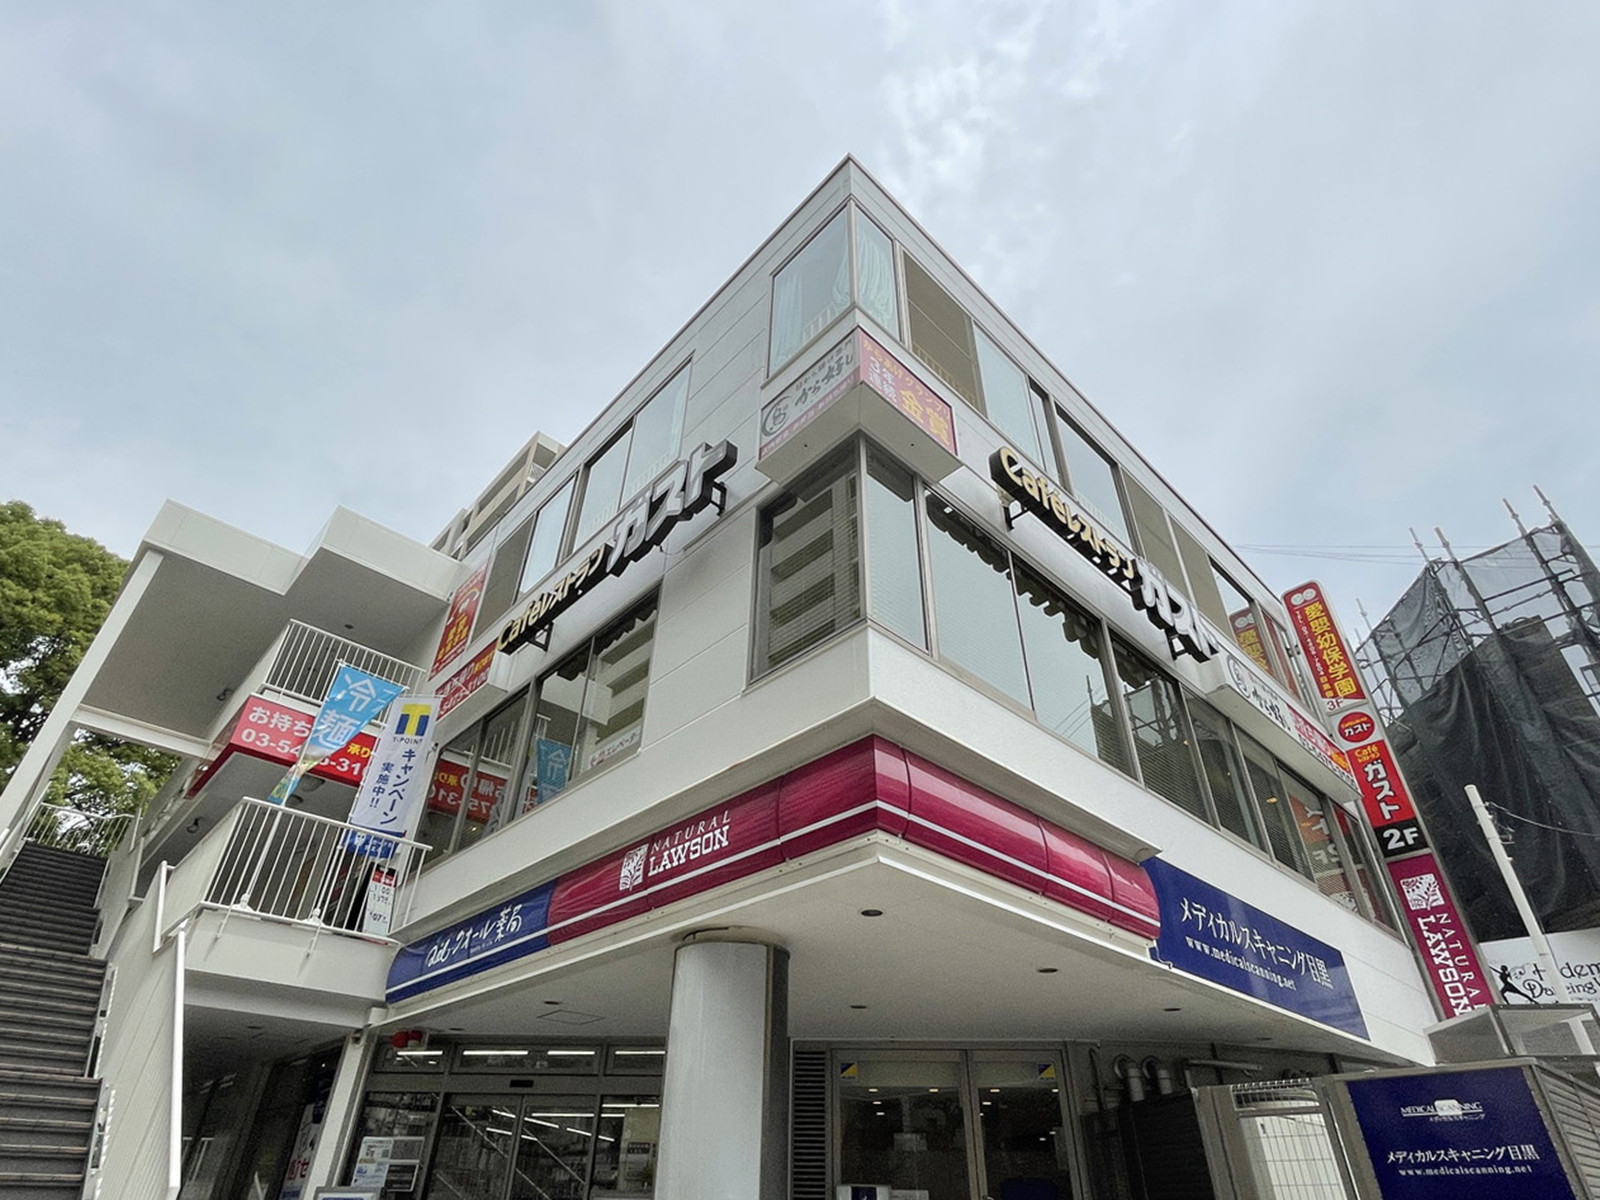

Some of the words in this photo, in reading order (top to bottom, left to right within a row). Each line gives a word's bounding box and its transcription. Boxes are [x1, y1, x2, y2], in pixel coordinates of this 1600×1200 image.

[1327, 698, 1343, 711] 3F
[1344, 723, 1371, 737] ガスト
[380, 749, 416, 824] キャンペーン
[1363, 760, 1399, 820] ガスト
[651, 810, 731, 854] NATURAL
[1383, 827, 1418, 849] 2F
[648, 825, 730, 877] LAWSON
[1418, 915, 1474, 1017] LAWSON
[1387, 1144, 1540, 1164] メディカルスキャニング目黒
[1399, 1164, 1533, 1176] www.medicalscanning.net
